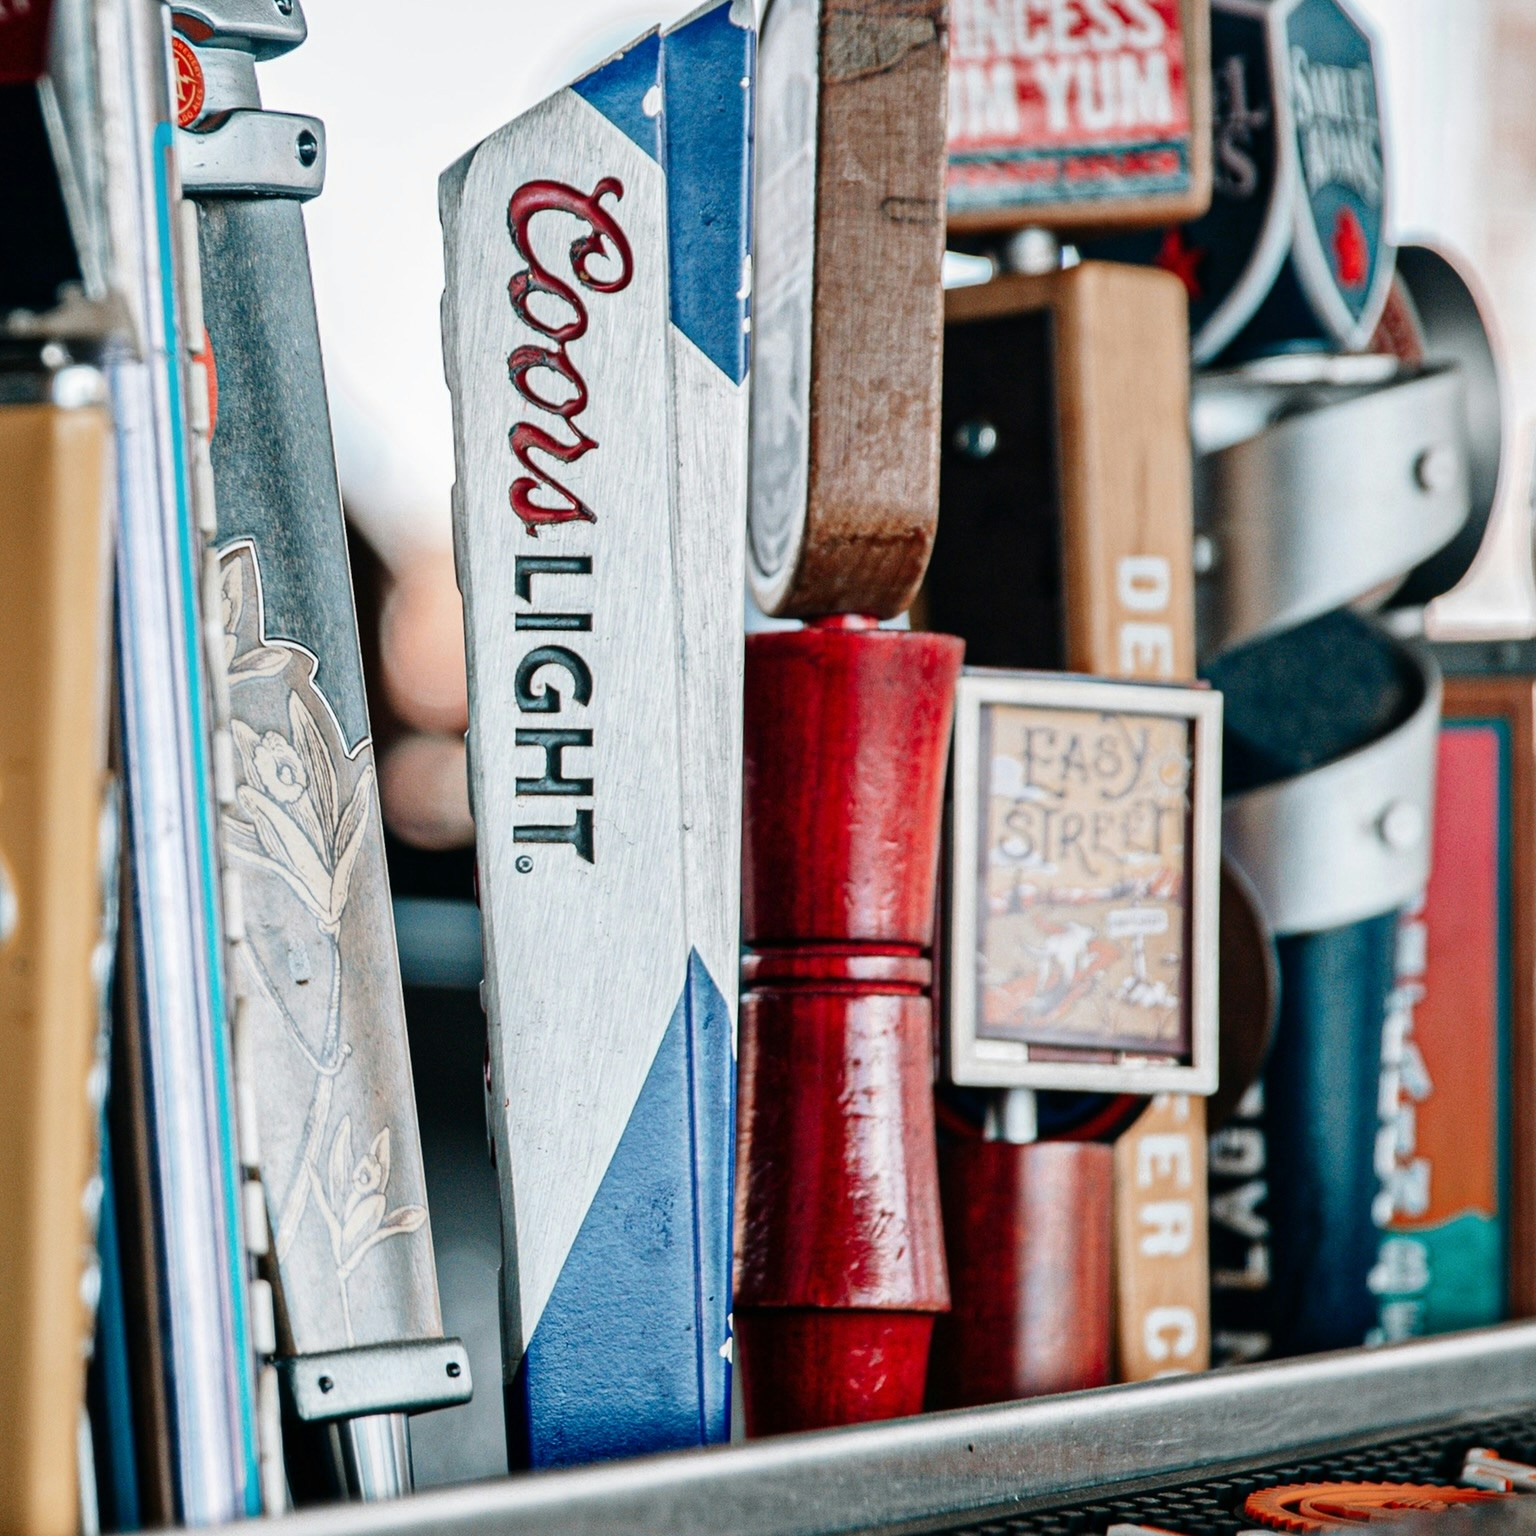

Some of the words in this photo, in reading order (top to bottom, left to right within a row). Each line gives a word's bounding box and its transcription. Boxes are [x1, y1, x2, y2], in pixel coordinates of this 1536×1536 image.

[1035, 48, 1173, 133] YUM
[507, 175, 634, 539] Coors
[513, 554, 596, 865] LIGHT
[1024, 721, 1151, 799] EASY
[998, 800, 1178, 876] STREET
